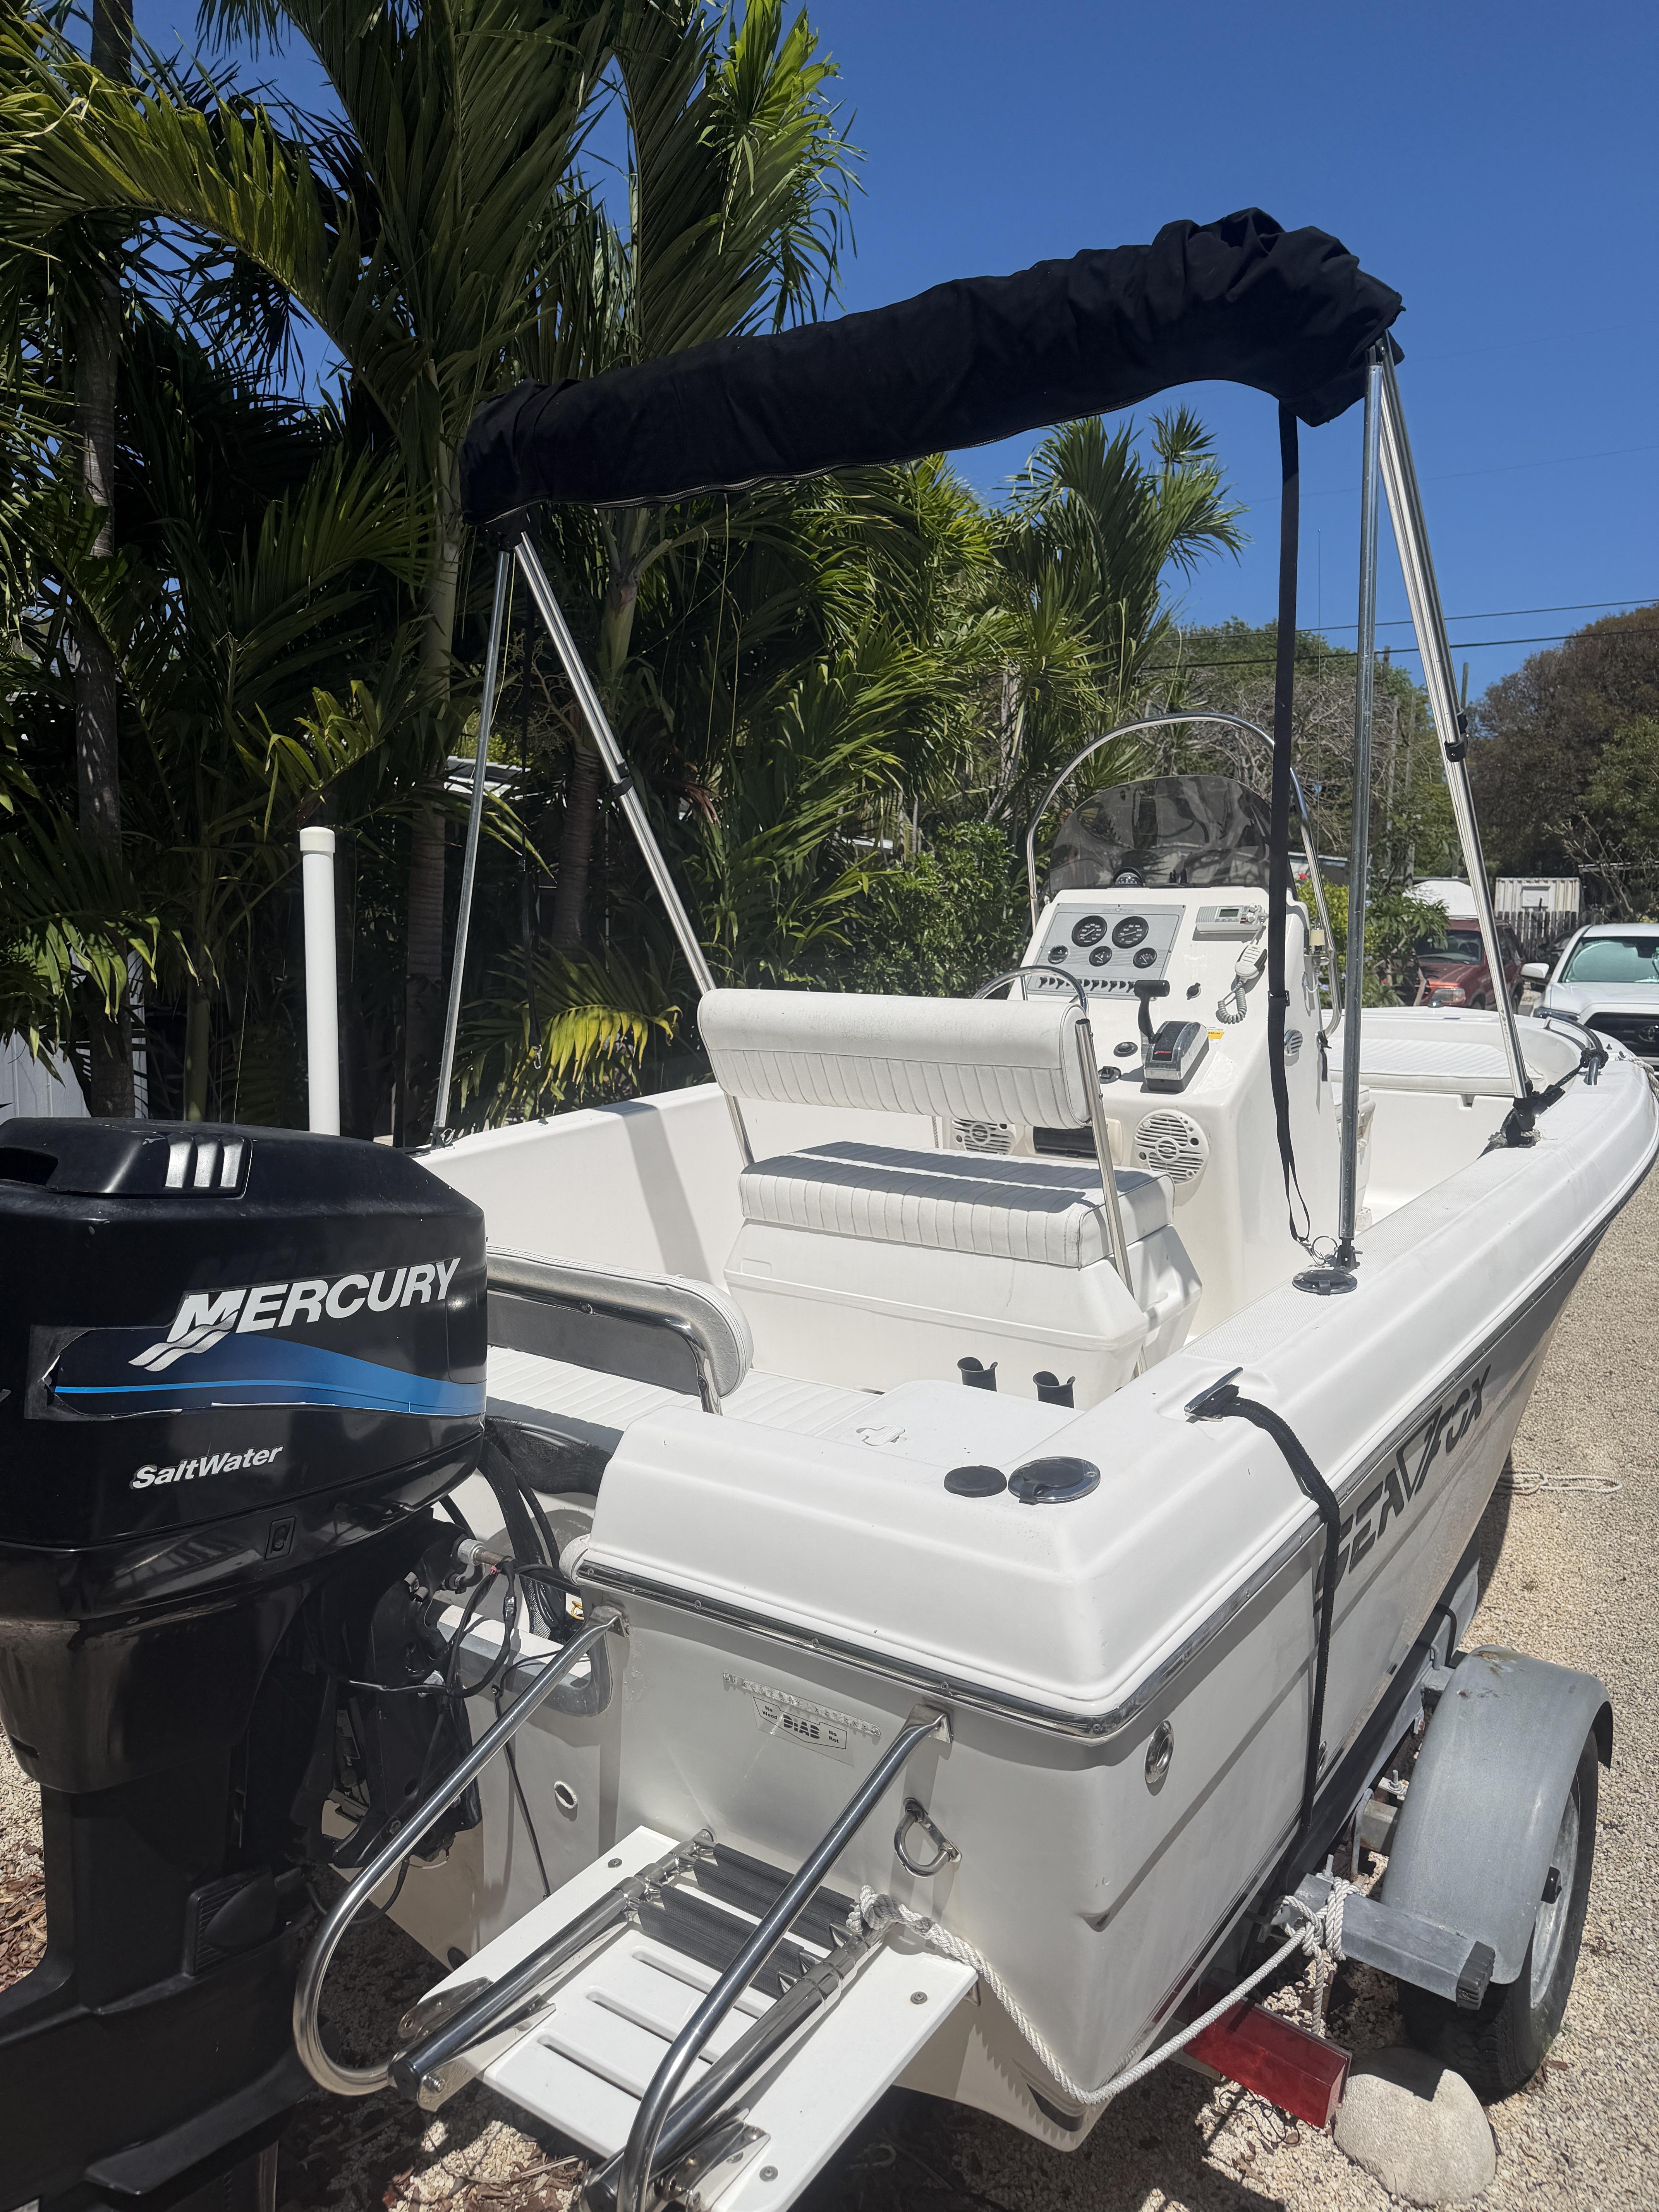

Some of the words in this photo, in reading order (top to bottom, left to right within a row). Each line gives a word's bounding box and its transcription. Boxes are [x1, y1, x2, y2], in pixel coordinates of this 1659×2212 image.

[167, 1257, 461, 1342] MERCURY
[132, 1445, 283, 1489] SaltWater
[762, 1710, 778, 1720] Wood
